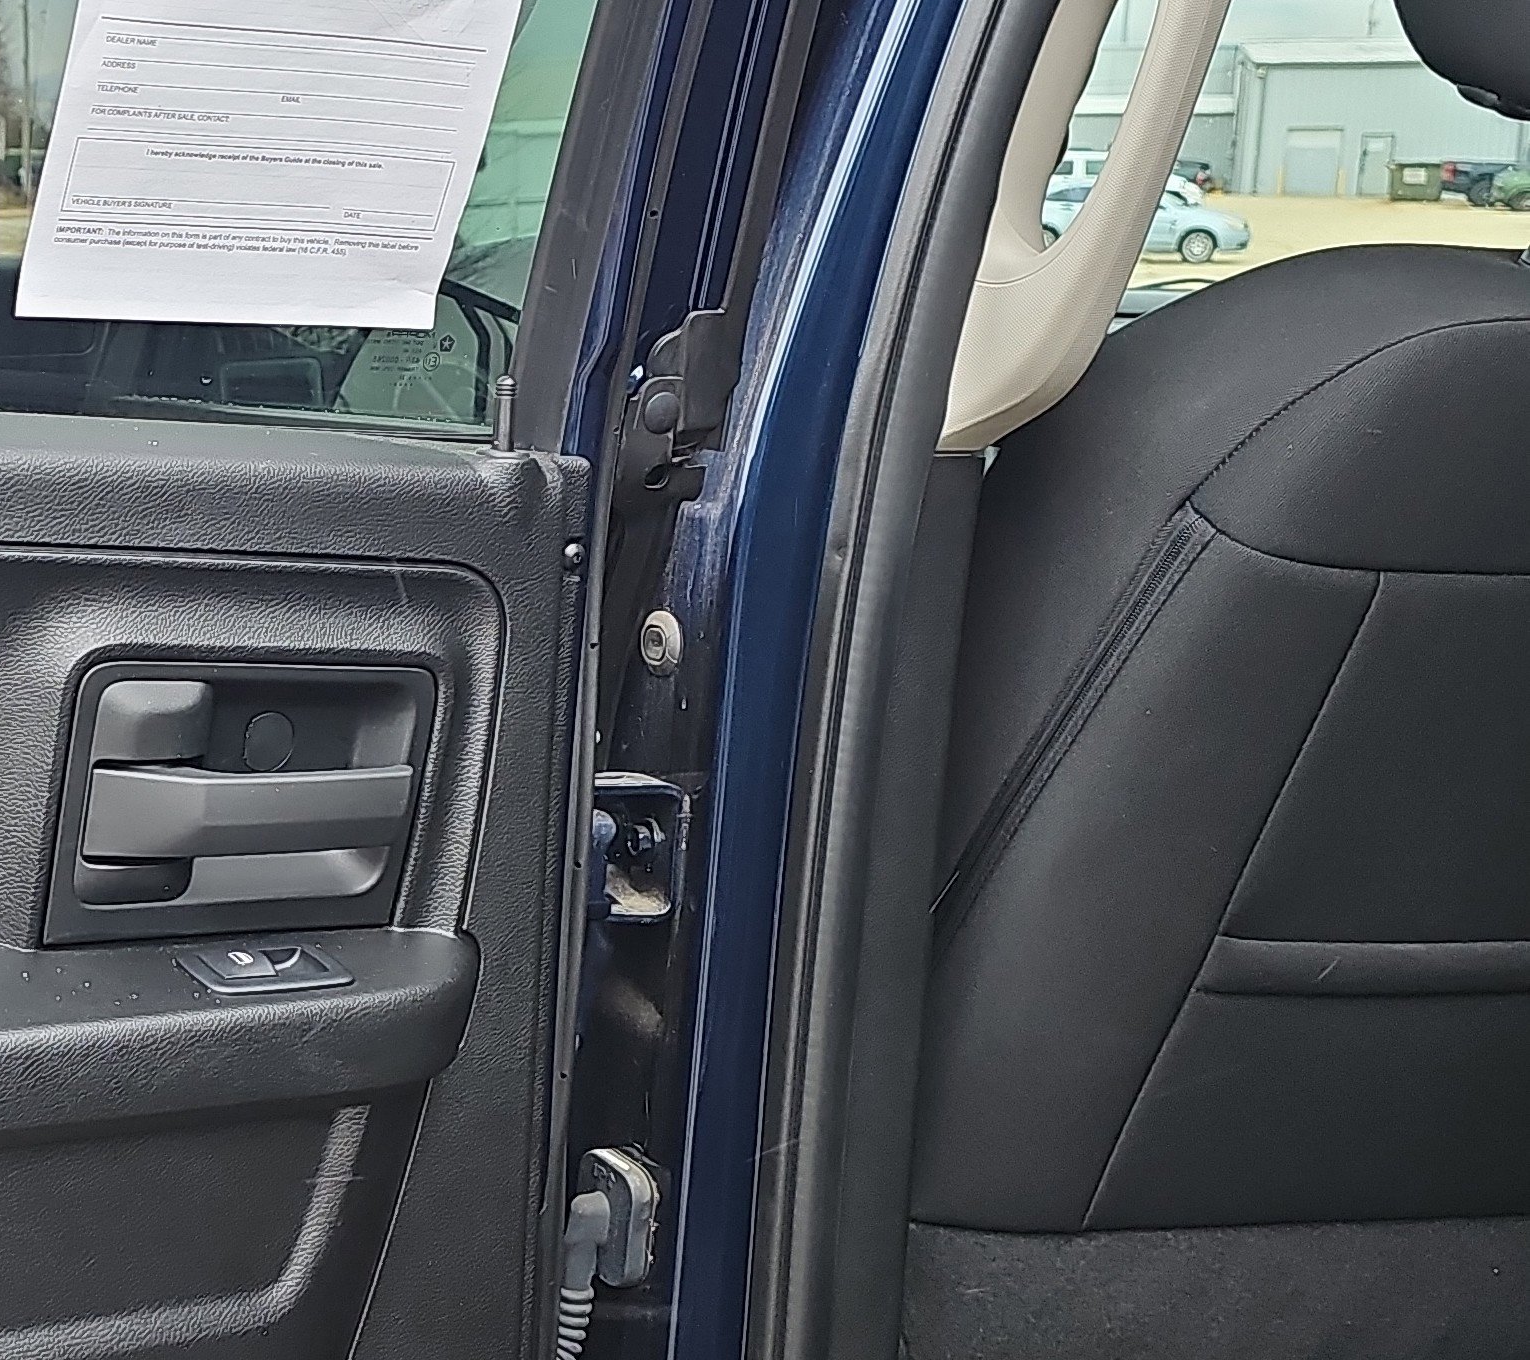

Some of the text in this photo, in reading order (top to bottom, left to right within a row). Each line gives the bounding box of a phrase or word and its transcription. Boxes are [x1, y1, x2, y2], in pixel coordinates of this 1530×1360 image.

[106, 35, 157, 47] DEALER NAME
[101, 60, 136, 70] ADDRESS
[97, 84, 139, 94] TELEPHONE
[280, 95, 301, 104] EMAIL
[91, 107, 107, 115] FOR
[107, 108, 153, 119] COMPLAINTS
[152, 111, 177, 120] AFTER
[150, 149, 174, 159] hereby
[173, 151, 217, 161] acknowledge
[217, 153, 241, 162] receipt
[260, 155, 283, 164] Buyers
[284, 156, 304, 164] Guide
[322, 158, 347, 168] closing
[71, 198, 102, 207] VEHICLE
[133, 200, 173, 210] SIGNATURE
[343, 211, 362, 220] DATE
[53, 236, 89, 244] consumer
[88, 238, 122, 246] purchase
[122, 238, 148, 248] (except
[158, 241, 187, 249] purpose
[195, 242, 235, 253] test-driving)
[235, 244, 261, 252] violates
[261, 244, 285, 253] federal
[56, 226, 104, 236] IMPORTANT:
[108, 228, 121, 237] The
[122, 228, 160, 238] information
[171, 231, 184, 239] this
[184, 231, 201, 240] form
[208, 233, 223, 241] part
[230, 235, 244, 243] any
[244, 235, 272, 243] contract
[279, 235, 292, 245] buy
[333, 238, 368, 249] Removing
[367, 241, 381, 249] this
[380, 241, 398, 250] label
[397, 243, 419, 251] before
